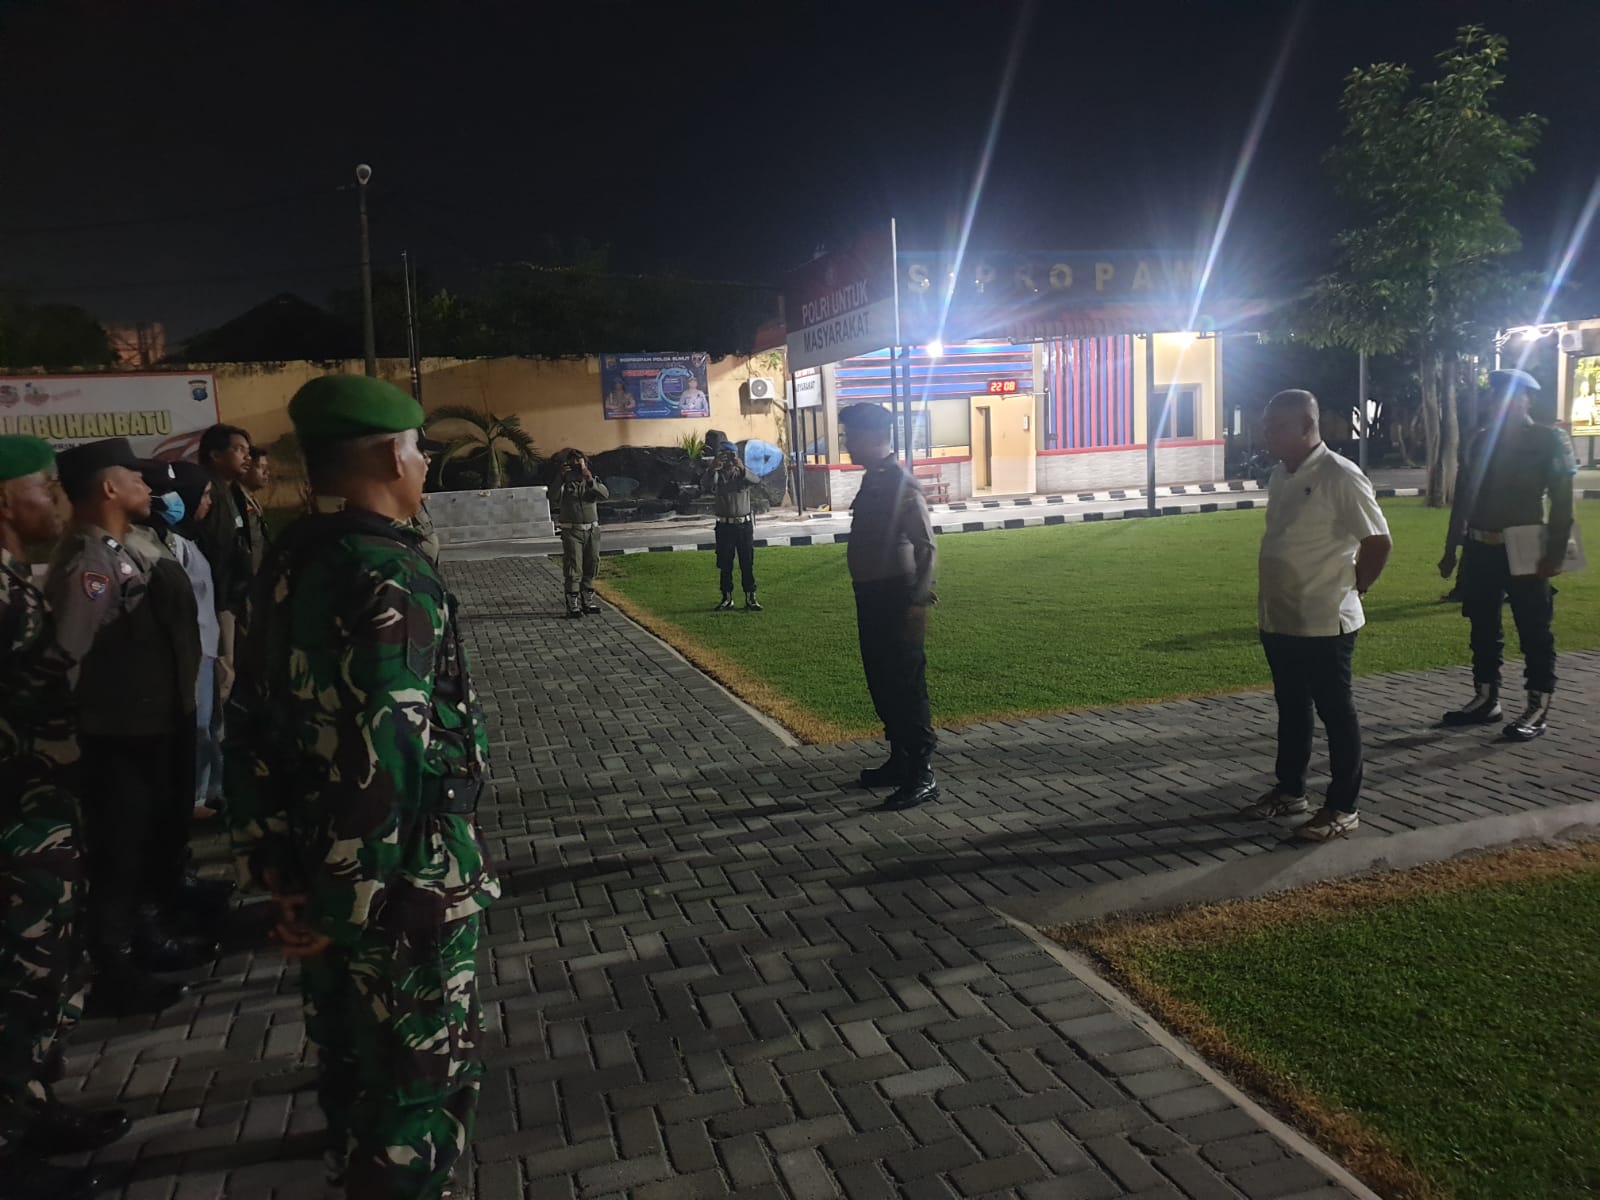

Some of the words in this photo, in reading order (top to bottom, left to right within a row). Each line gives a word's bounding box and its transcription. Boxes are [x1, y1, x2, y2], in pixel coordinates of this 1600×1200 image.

[802, 296, 829, 325] POLRI
[831, 279, 869, 312] UNTUK
[803, 312, 870, 352] MASYARAKAT
